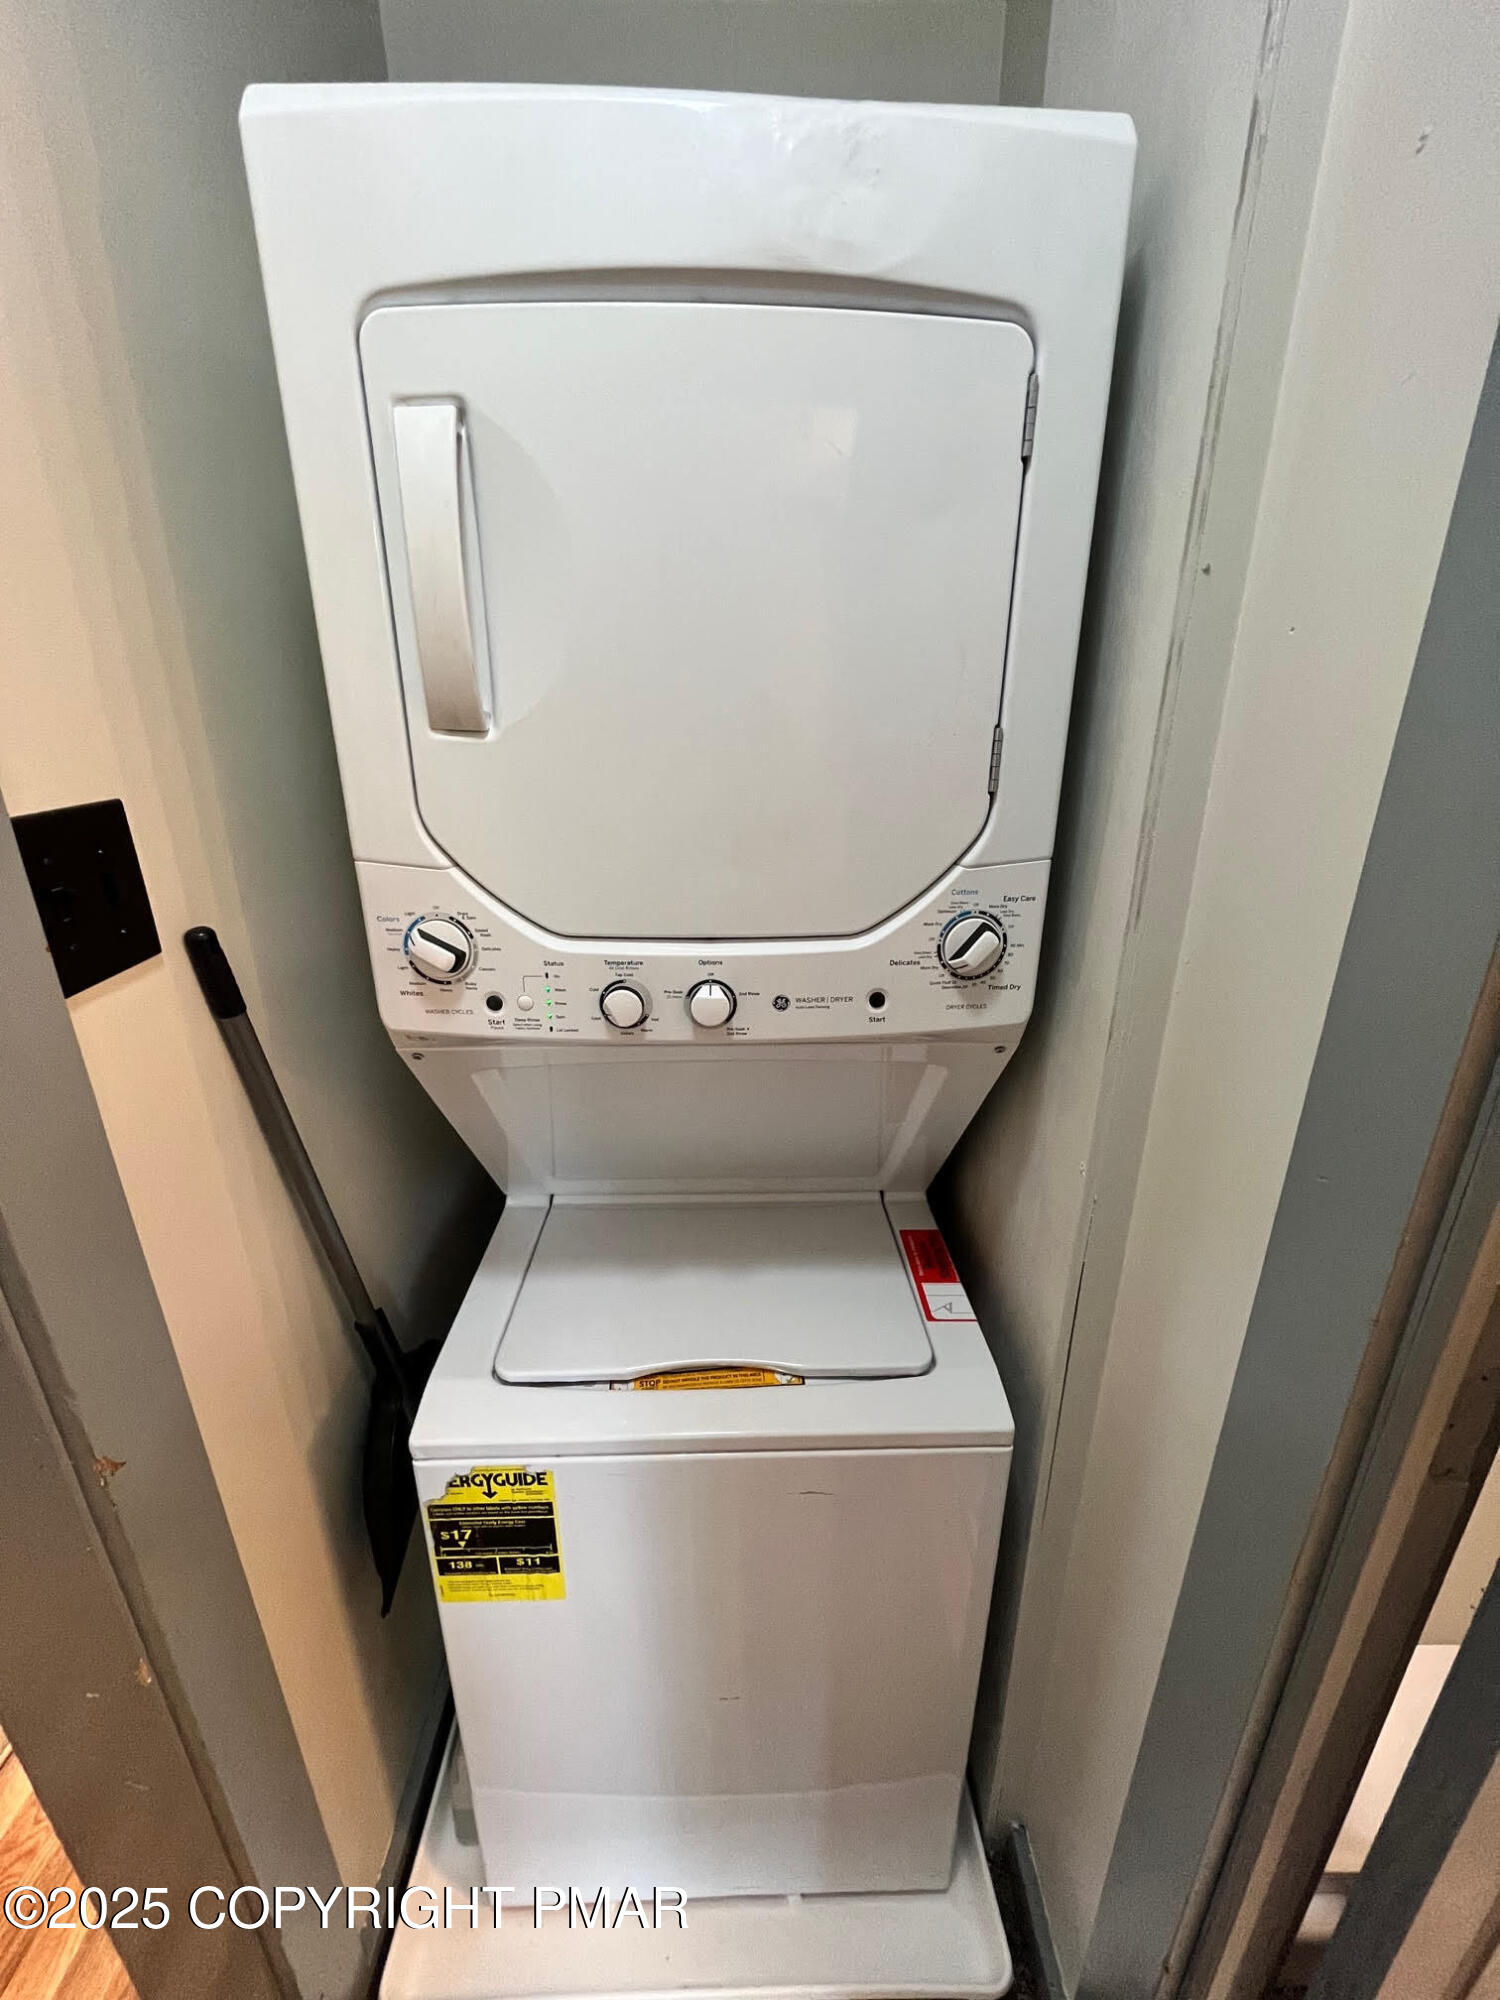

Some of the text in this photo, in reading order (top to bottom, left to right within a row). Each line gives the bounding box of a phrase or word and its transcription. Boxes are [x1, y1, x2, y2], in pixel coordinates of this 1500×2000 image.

[604, 959, 644, 967] Temperature
[698, 959, 723, 967] Options
[440, 1529, 472, 1541] $17
[448, 1561, 472, 1569] 138
[516, 1557, 540, 1566] $11
